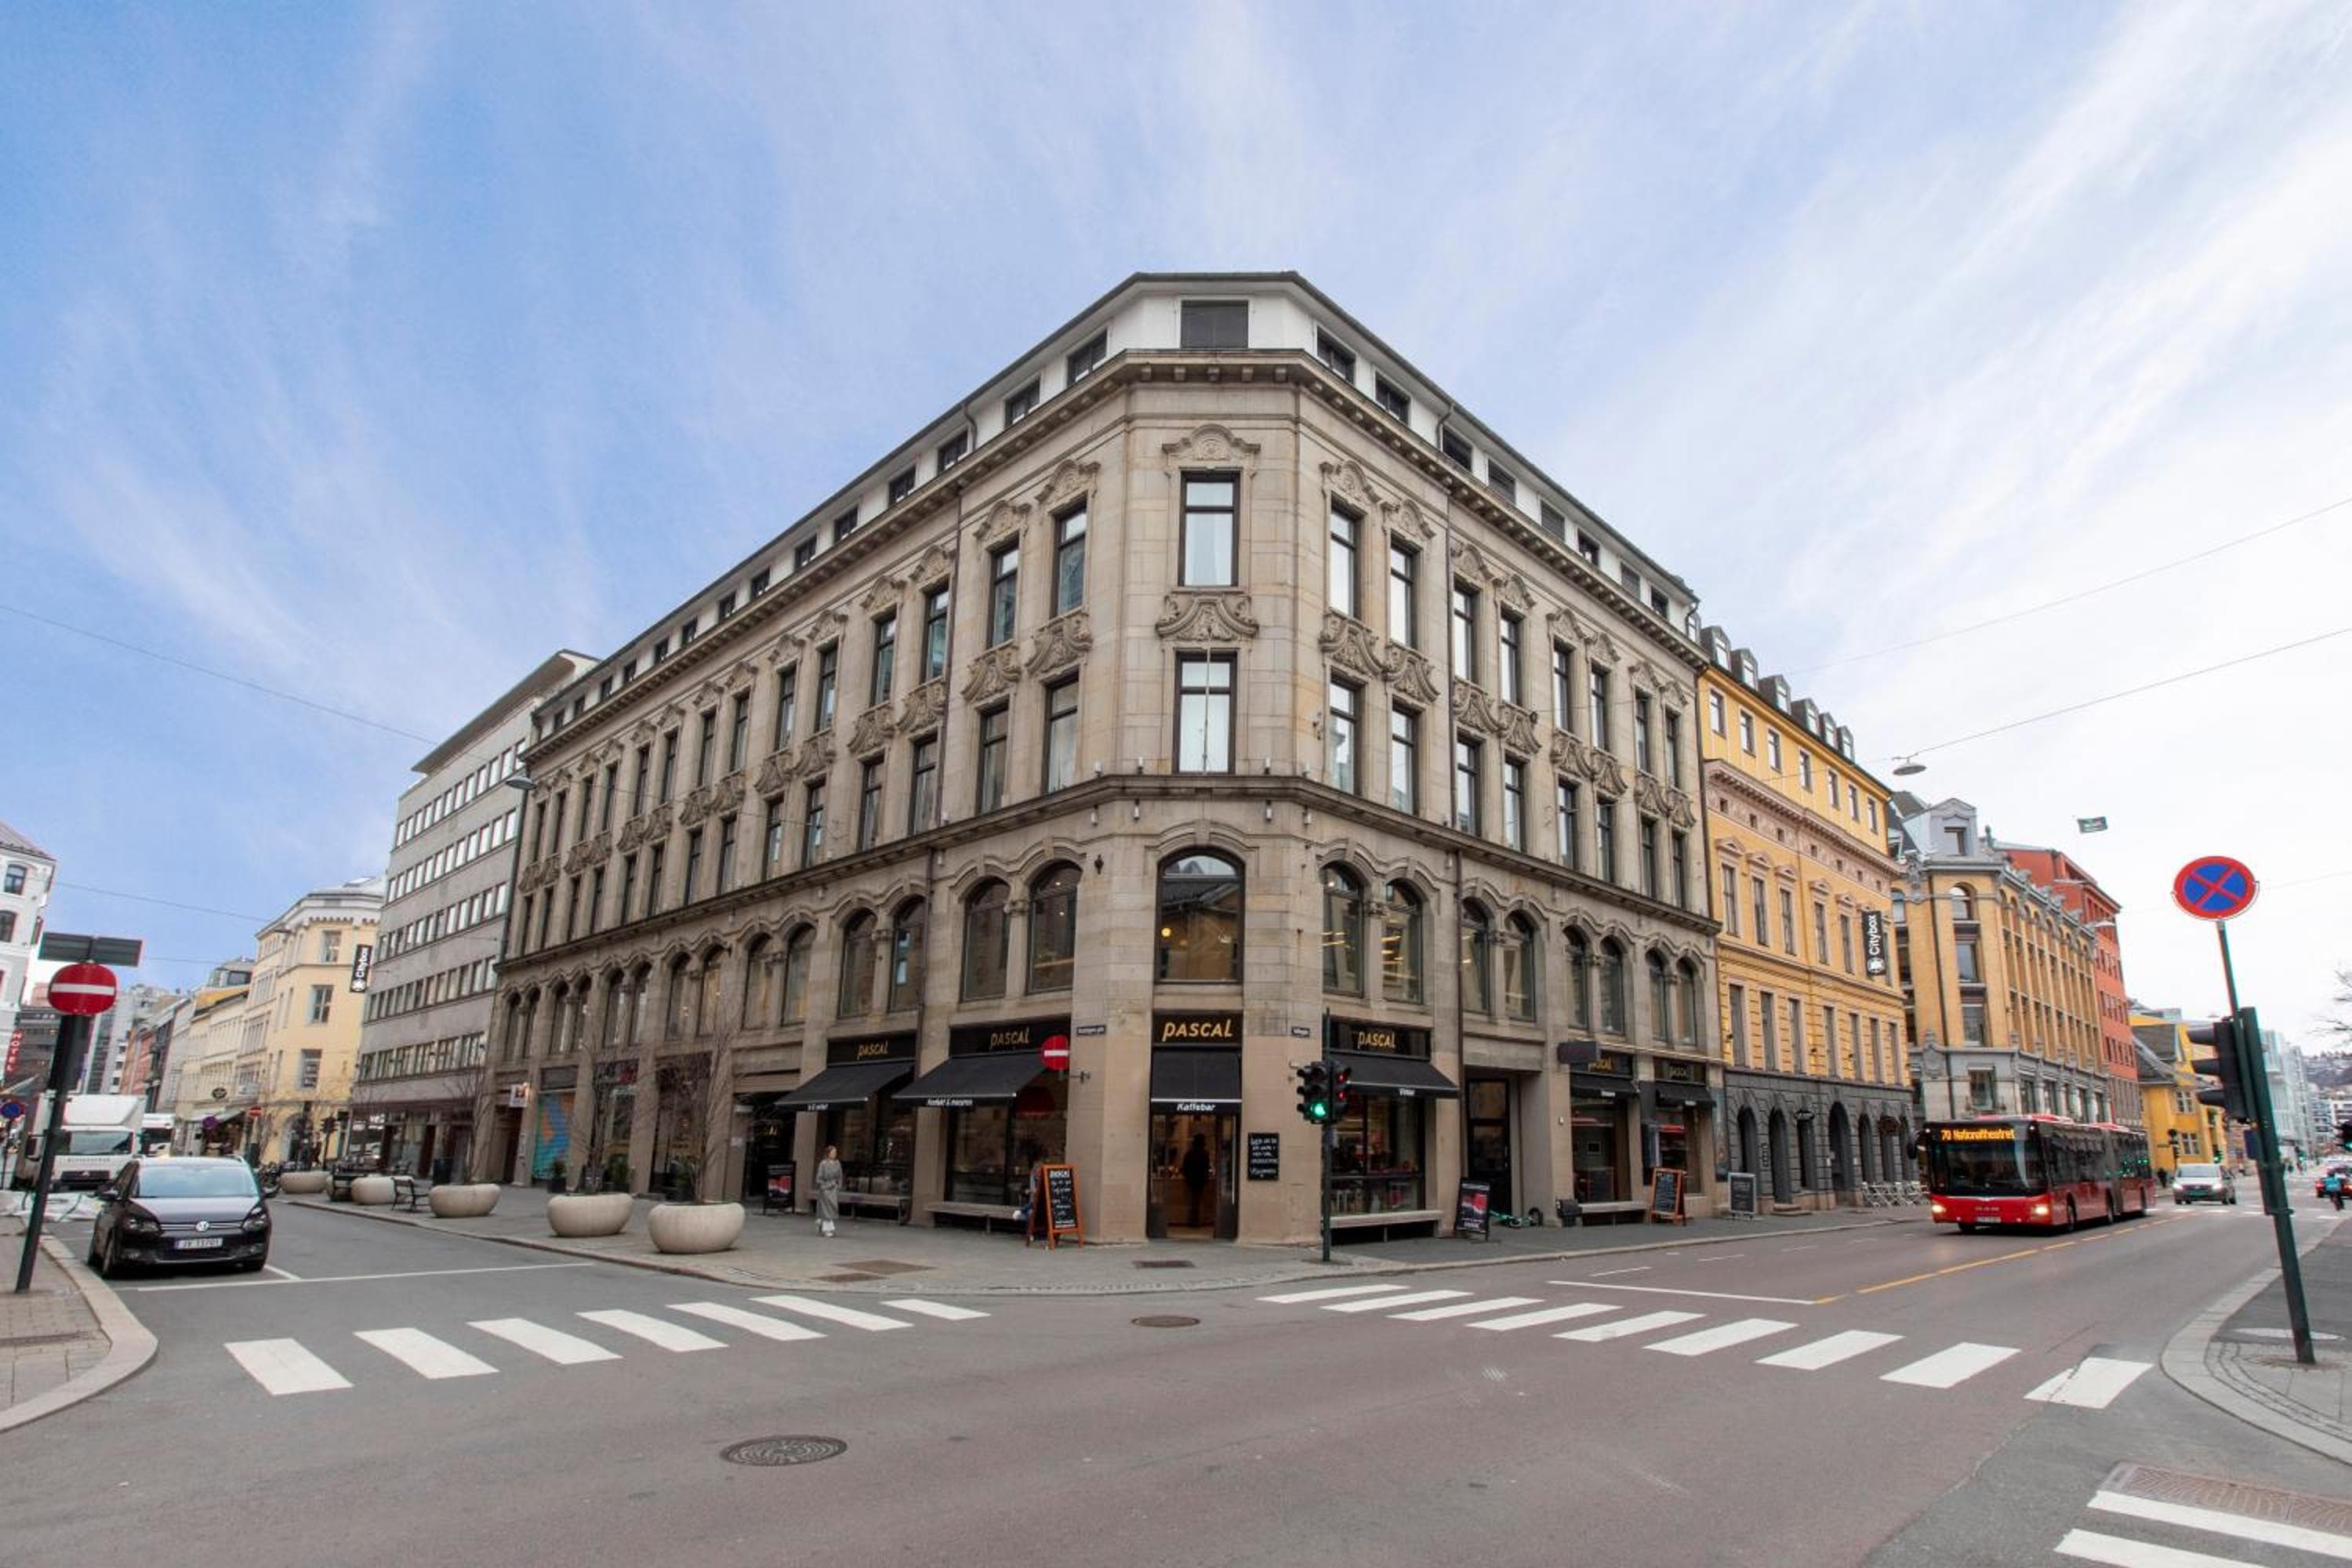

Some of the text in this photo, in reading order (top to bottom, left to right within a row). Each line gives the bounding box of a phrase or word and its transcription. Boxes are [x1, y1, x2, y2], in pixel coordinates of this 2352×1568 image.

[1867, 914, 1882, 955] Citybox
[989, 1026, 1029, 1051] PASCAL
[1161, 1019, 1232, 1042] PASCAL
[1356, 1031, 1396, 1050] PASCAL
[7, 1033, 23, 1072] HOTEL
[856, 1040, 888, 1060] PASCAL
[1940, 1129, 1952, 1142] 70
